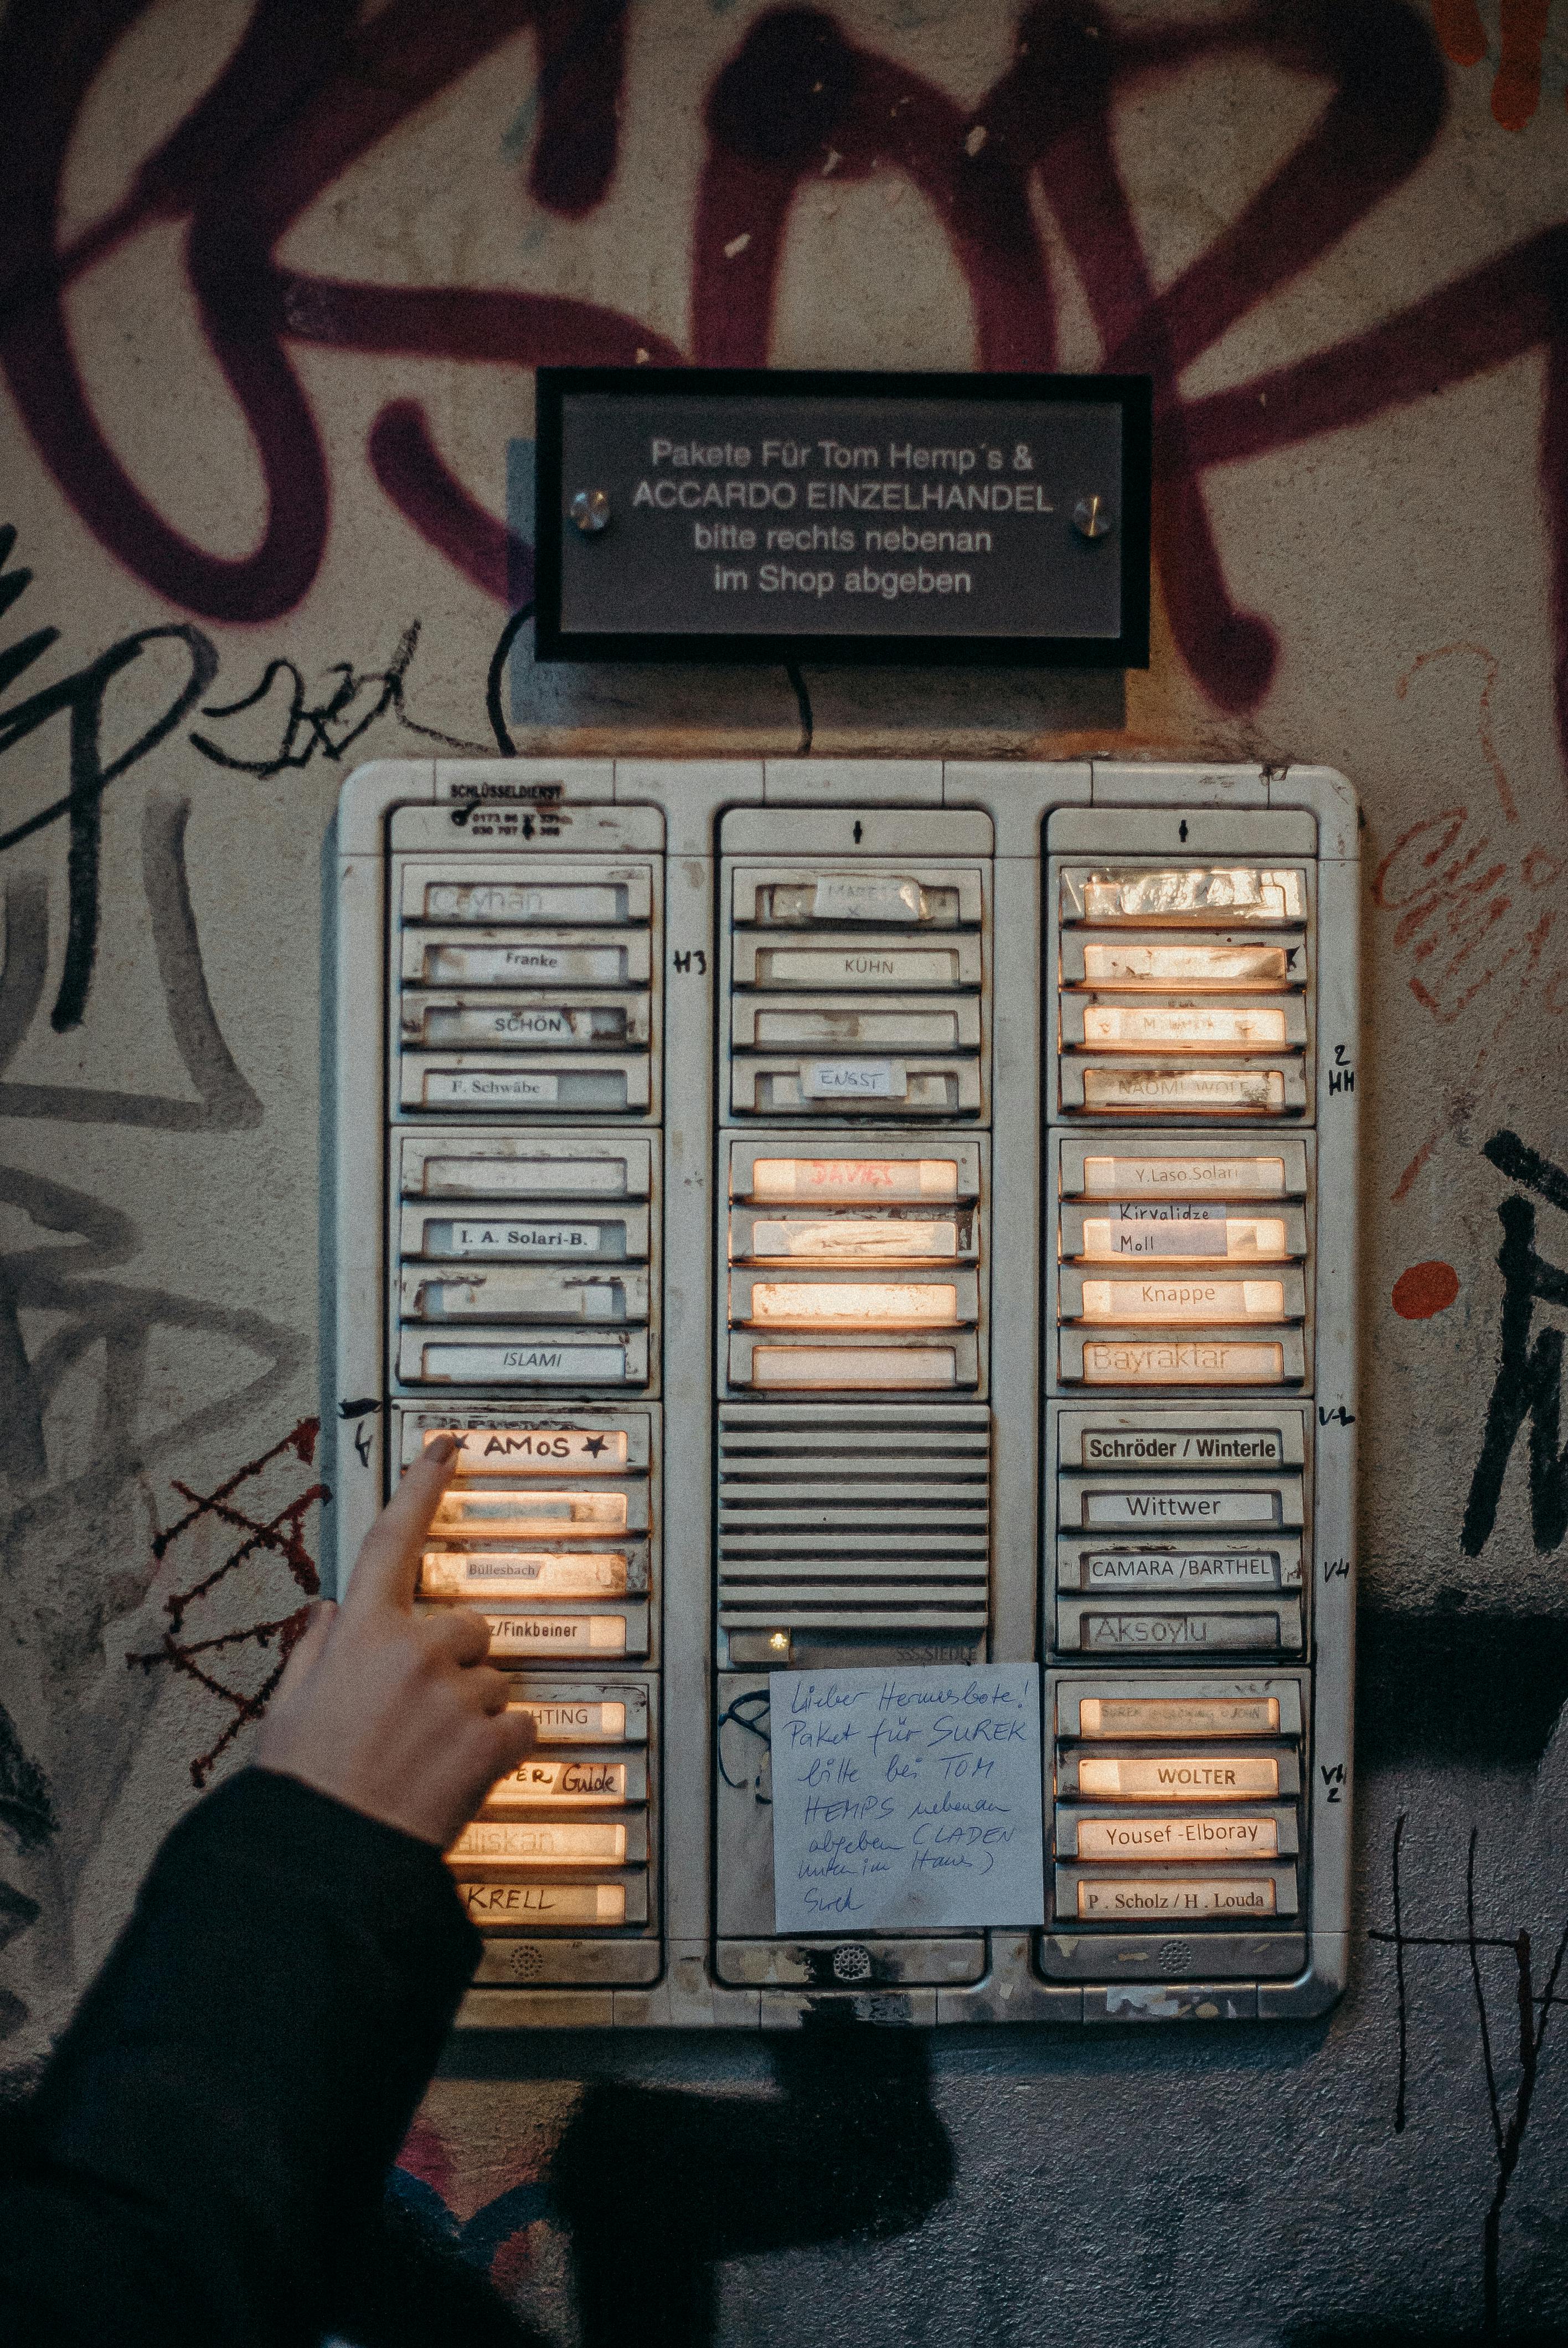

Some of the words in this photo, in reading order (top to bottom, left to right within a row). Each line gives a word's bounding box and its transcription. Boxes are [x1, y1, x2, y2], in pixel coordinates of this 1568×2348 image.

[651, 439, 752, 468] Pakete
[762, 439, 810, 468] Für
[818, 441, 879, 468] Tom
[1012, 444, 1034, 471] &
[633, 481, 796, 509] ACCARDO
[808, 483, 1053, 512] EINZELHANDEL
[695, 522, 758, 550] bitte
[767, 524, 854, 552] rechts
[865, 527, 992, 554] nebenan
[715, 565, 747, 590] im
[759, 565, 834, 598] Shop
[844, 566, 971, 600] abgeben
[506, 952, 559, 968] Franke
[494, 1013, 561, 1032] SCHÖN
[1334, 1044, 1351, 1067] 2
[1120, 1235, 1154, 1253] Moll
[1142, 1285, 1216, 1306] Knappe
[503, 1352, 562, 1368] ISLAMI
[1093, 1344, 1231, 1374] Bayraktar
[1090, 1438, 1177, 1459] Schröder
[1183, 1439, 1190, 1458] /
[1196, 1438, 1276, 1458] Winterle
[1126, 1496, 1222, 1516] Wittwer
[469, 1563, 536, 1577] Büllesbach
[1091, 1559, 1174, 1578] CAMARA
[1095, 1617, 1208, 1645] Aksoylu
[783, 1720, 859, 1749] Paket
[868, 1717, 922, 1757] für
[927, 1716, 1027, 1747] SUREK
[798, 1757, 859, 1787] bitte
[886, 1753, 922, 1783] bei
[938, 1752, 995, 1780] TOM
[1158, 1768, 1236, 1785] WOLTER
[804, 1795, 895, 1825] HEMPS
[908, 1790, 1012, 1819] nebenan
[809, 1830, 906, 1858] abgeben
[1106, 1826, 1172, 1846] Yousef
[467, 1886, 557, 1910] KRELL
[1115, 1893, 1169, 1909] Scholz
[1213, 1891, 1265, 1908] Louda
